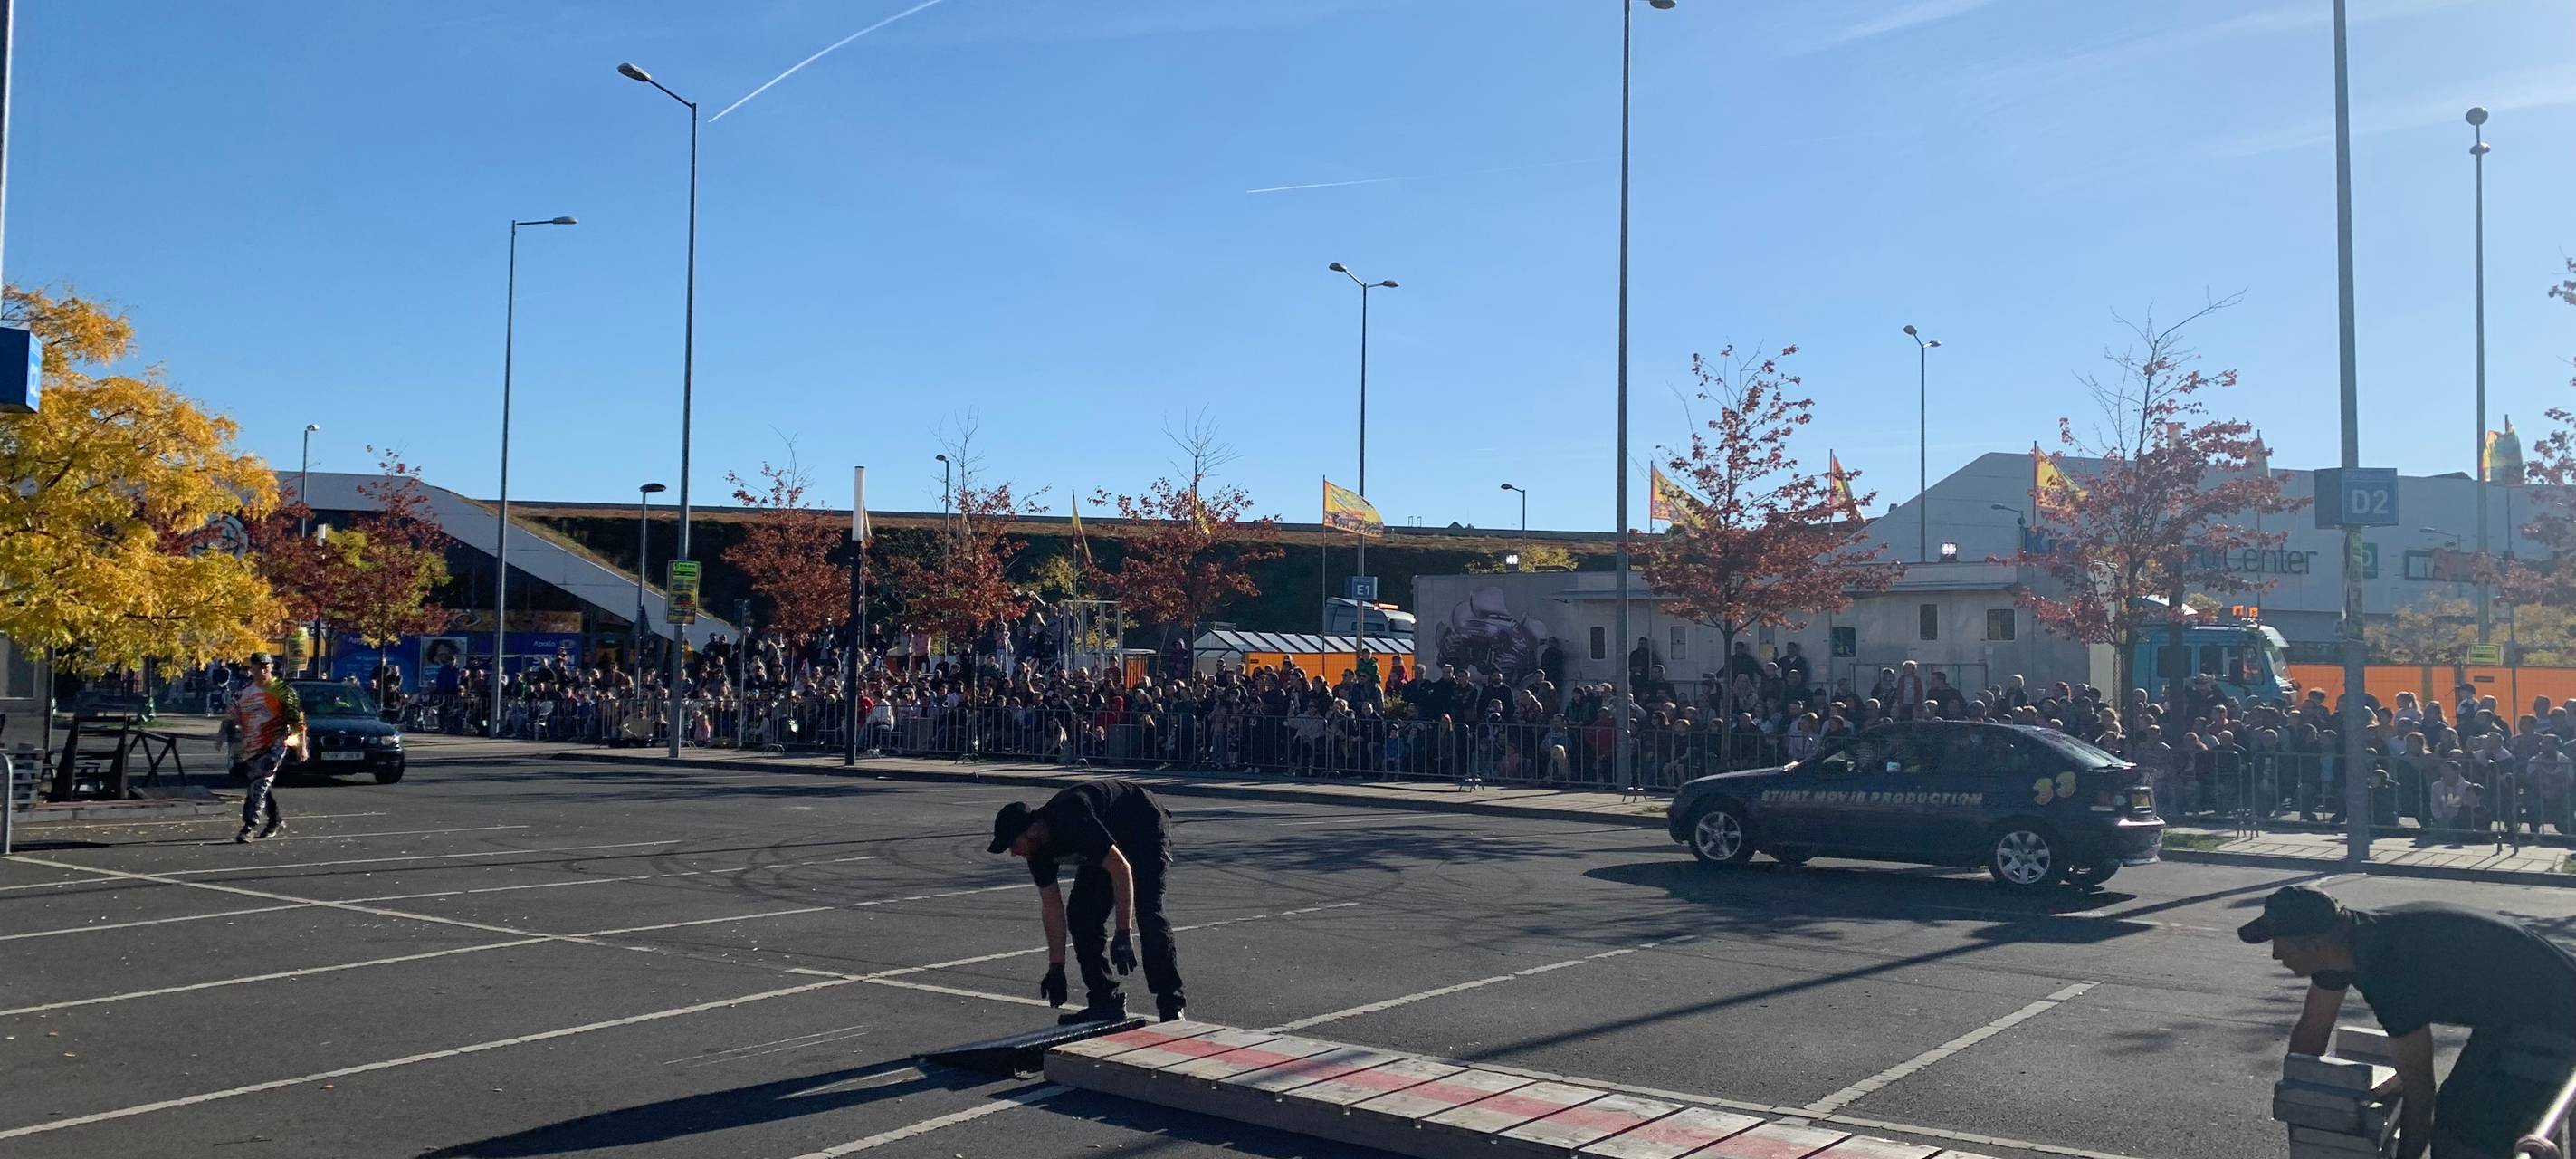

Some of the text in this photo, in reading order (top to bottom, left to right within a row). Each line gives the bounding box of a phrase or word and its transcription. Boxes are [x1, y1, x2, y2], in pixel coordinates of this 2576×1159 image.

[2351, 489, 2389, 515] D2
[1357, 584, 1370, 596] E1
[1869, 791, 1984, 807] PRODUCTION
